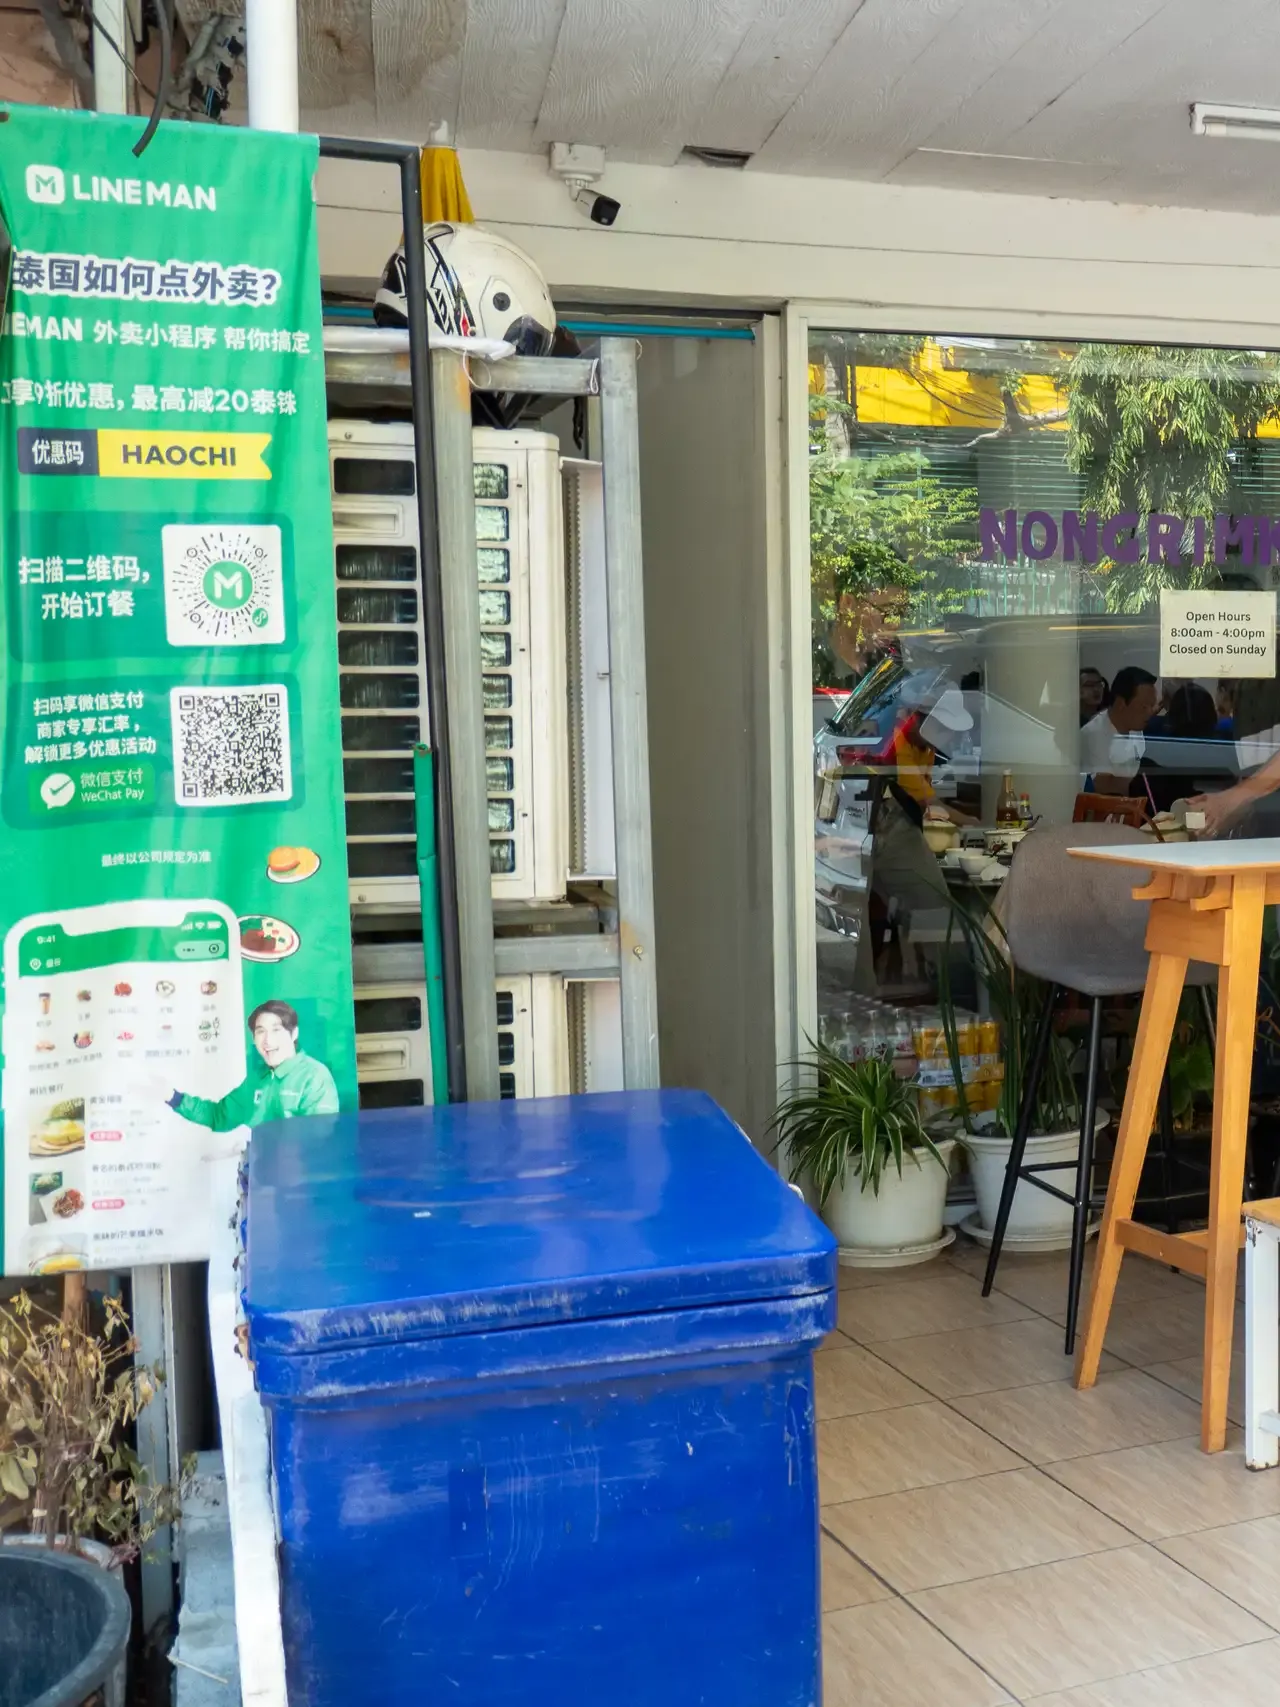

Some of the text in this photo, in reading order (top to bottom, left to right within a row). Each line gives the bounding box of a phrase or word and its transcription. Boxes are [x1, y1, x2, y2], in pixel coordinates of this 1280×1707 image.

[72, 174, 142, 204] LINE
[146, 184, 217, 211] MAN
[94, 320, 217, 349] 外卖小程序
[224, 330, 311, 354] 帮你搞定
[31, 439, 85, 466] 优惠码
[122, 443, 237, 467] HAOCHI
[18, 554, 151, 585] 扫描二维码,
[41, 589, 136, 620] 开始订餐
[1186, 611, 1251, 623] Open Hours
[1171, 628, 1213, 638] 8:00am
[1222, 628, 1265, 640] 4:00pm
[1169, 644, 1207, 654] Closed
[1226, 644, 1267, 656] Sunday
[33, 690, 144, 716] 扫码享微信支付
[24, 736, 157, 764] 解锁更多优惠活动
[80, 767, 143, 789] 微信支付
[81, 787, 145, 803] WeChat Pay
[36, 935, 56, 944] 9:41
